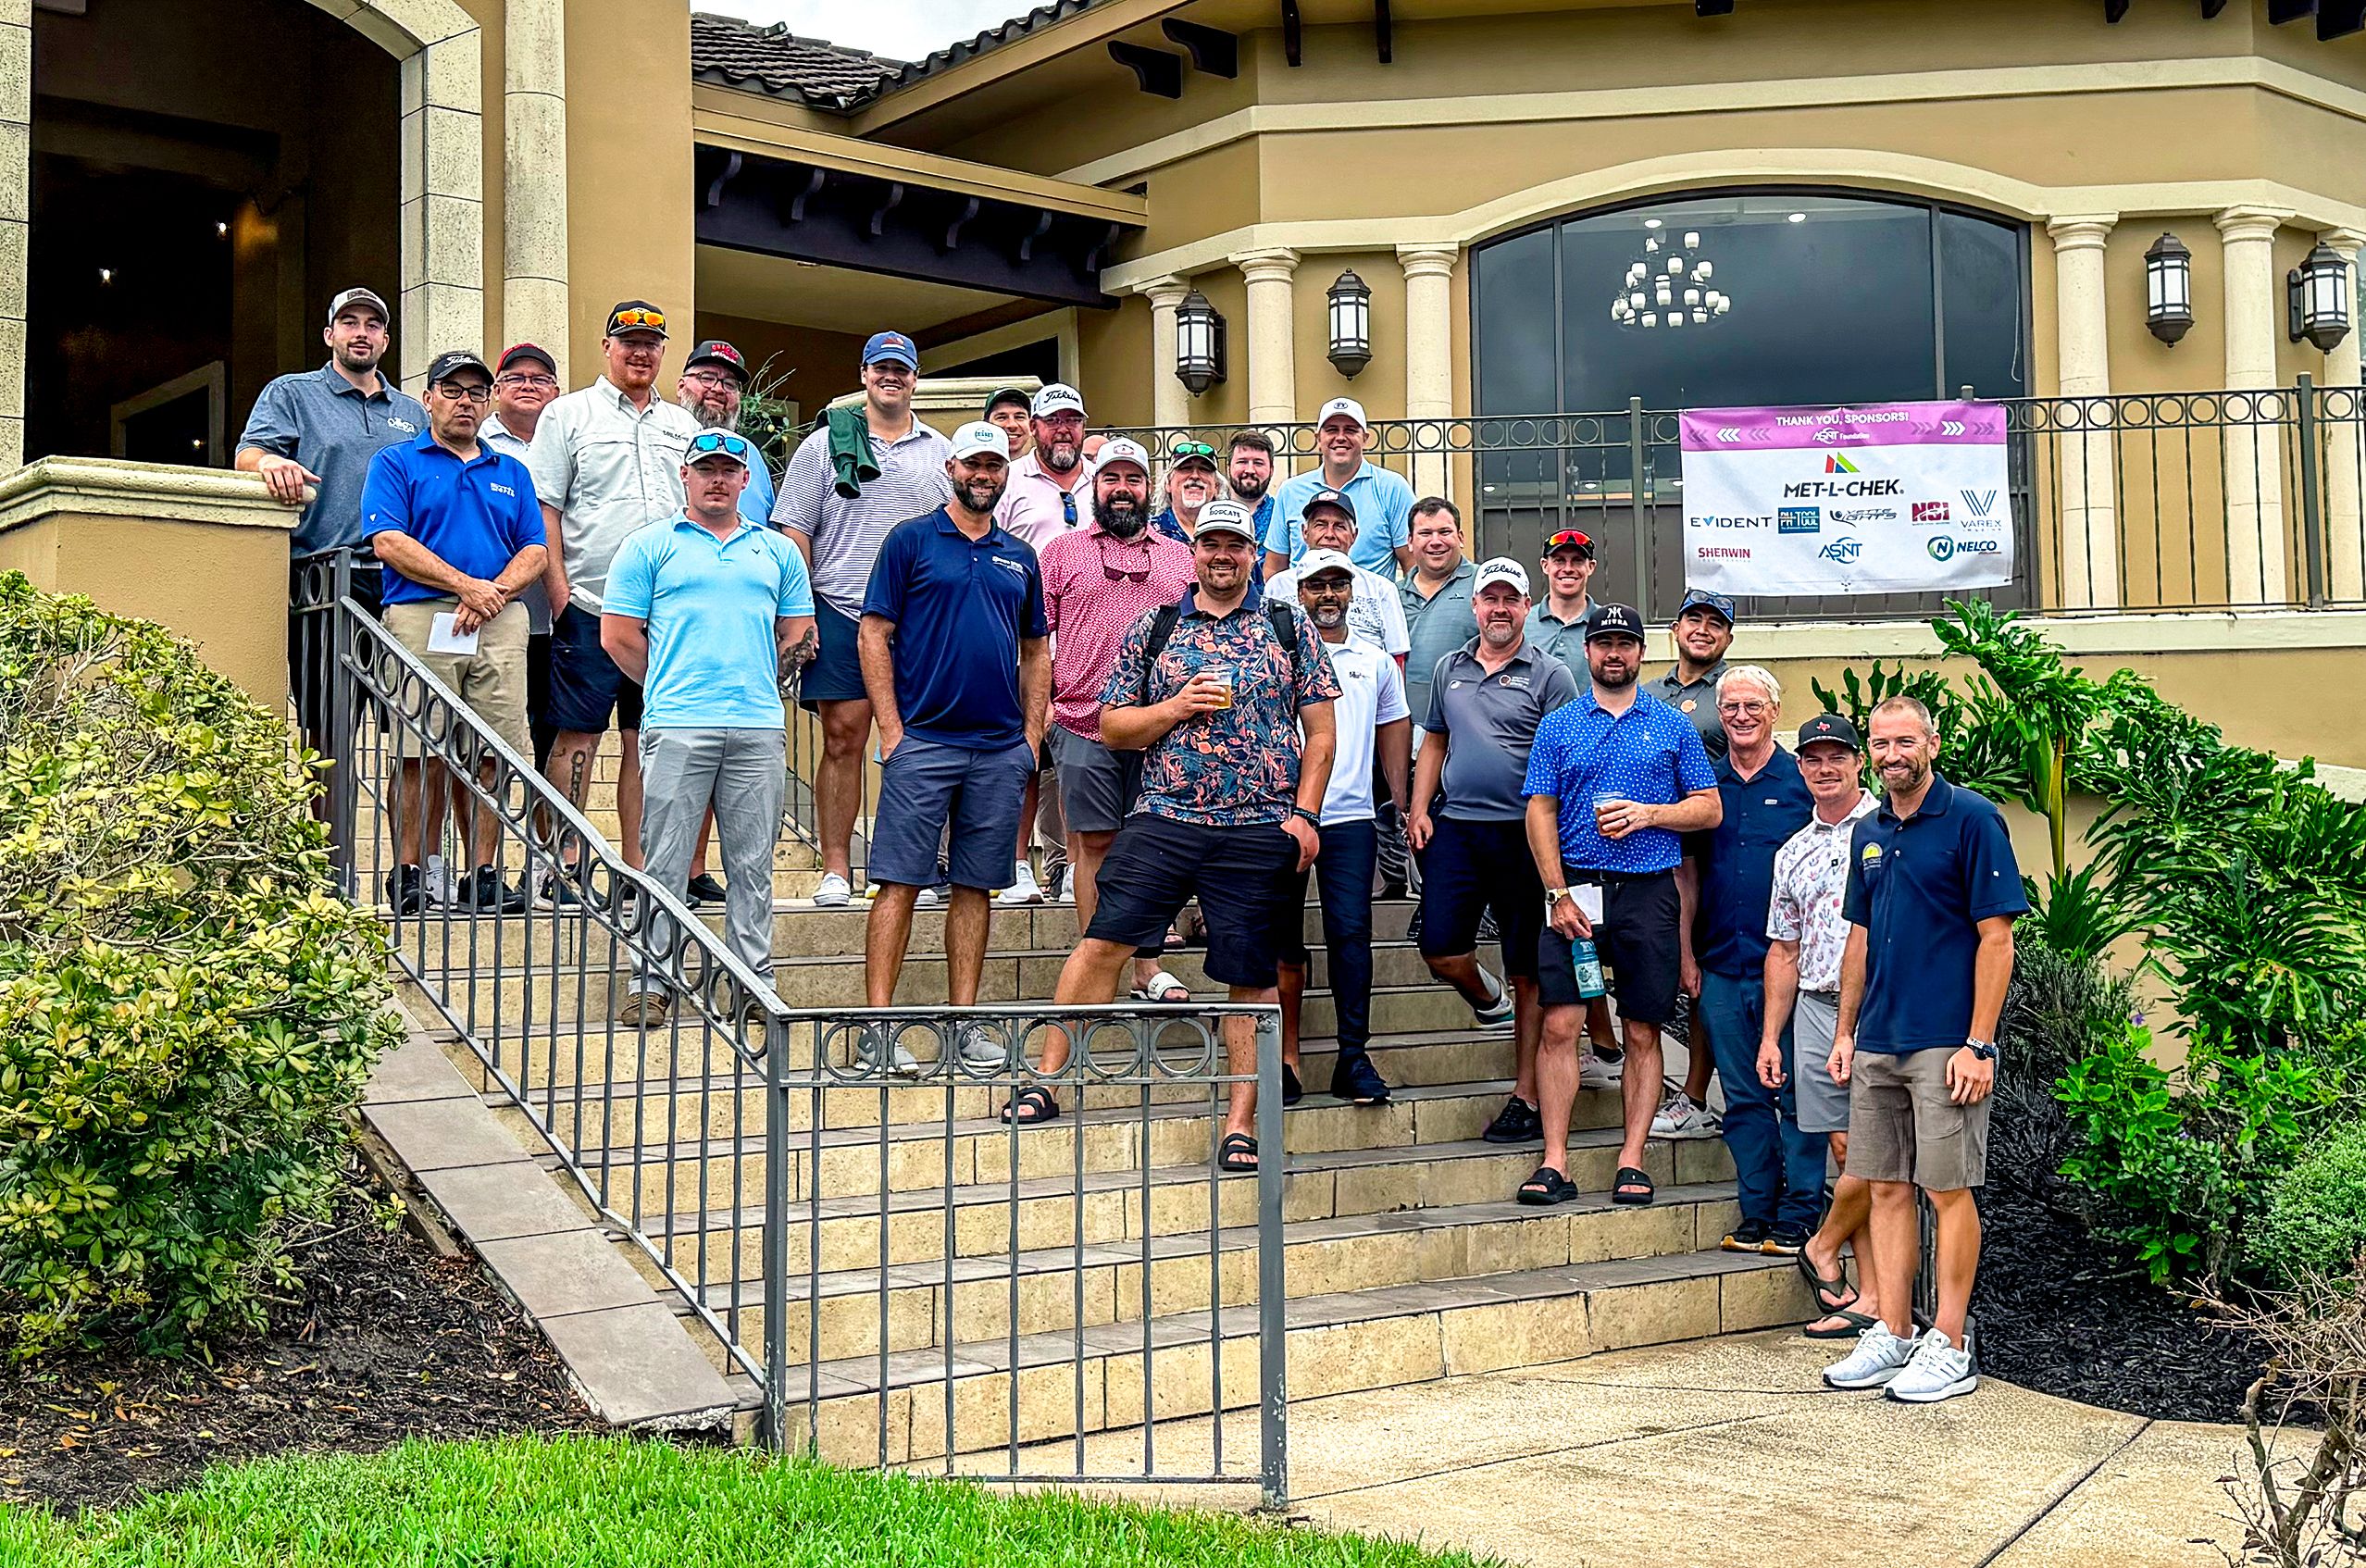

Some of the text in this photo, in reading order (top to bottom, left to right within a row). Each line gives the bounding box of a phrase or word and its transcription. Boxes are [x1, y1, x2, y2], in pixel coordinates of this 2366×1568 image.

[1775, 412, 1909, 426] THANK YOU, SPONSORS!
[1690, 516, 1772, 528] EVIDENT
[1699, 547, 1750, 558] SHERWIN
[1818, 541, 1862, 561] ASNT
[1957, 541, 1997, 553] NELCO
